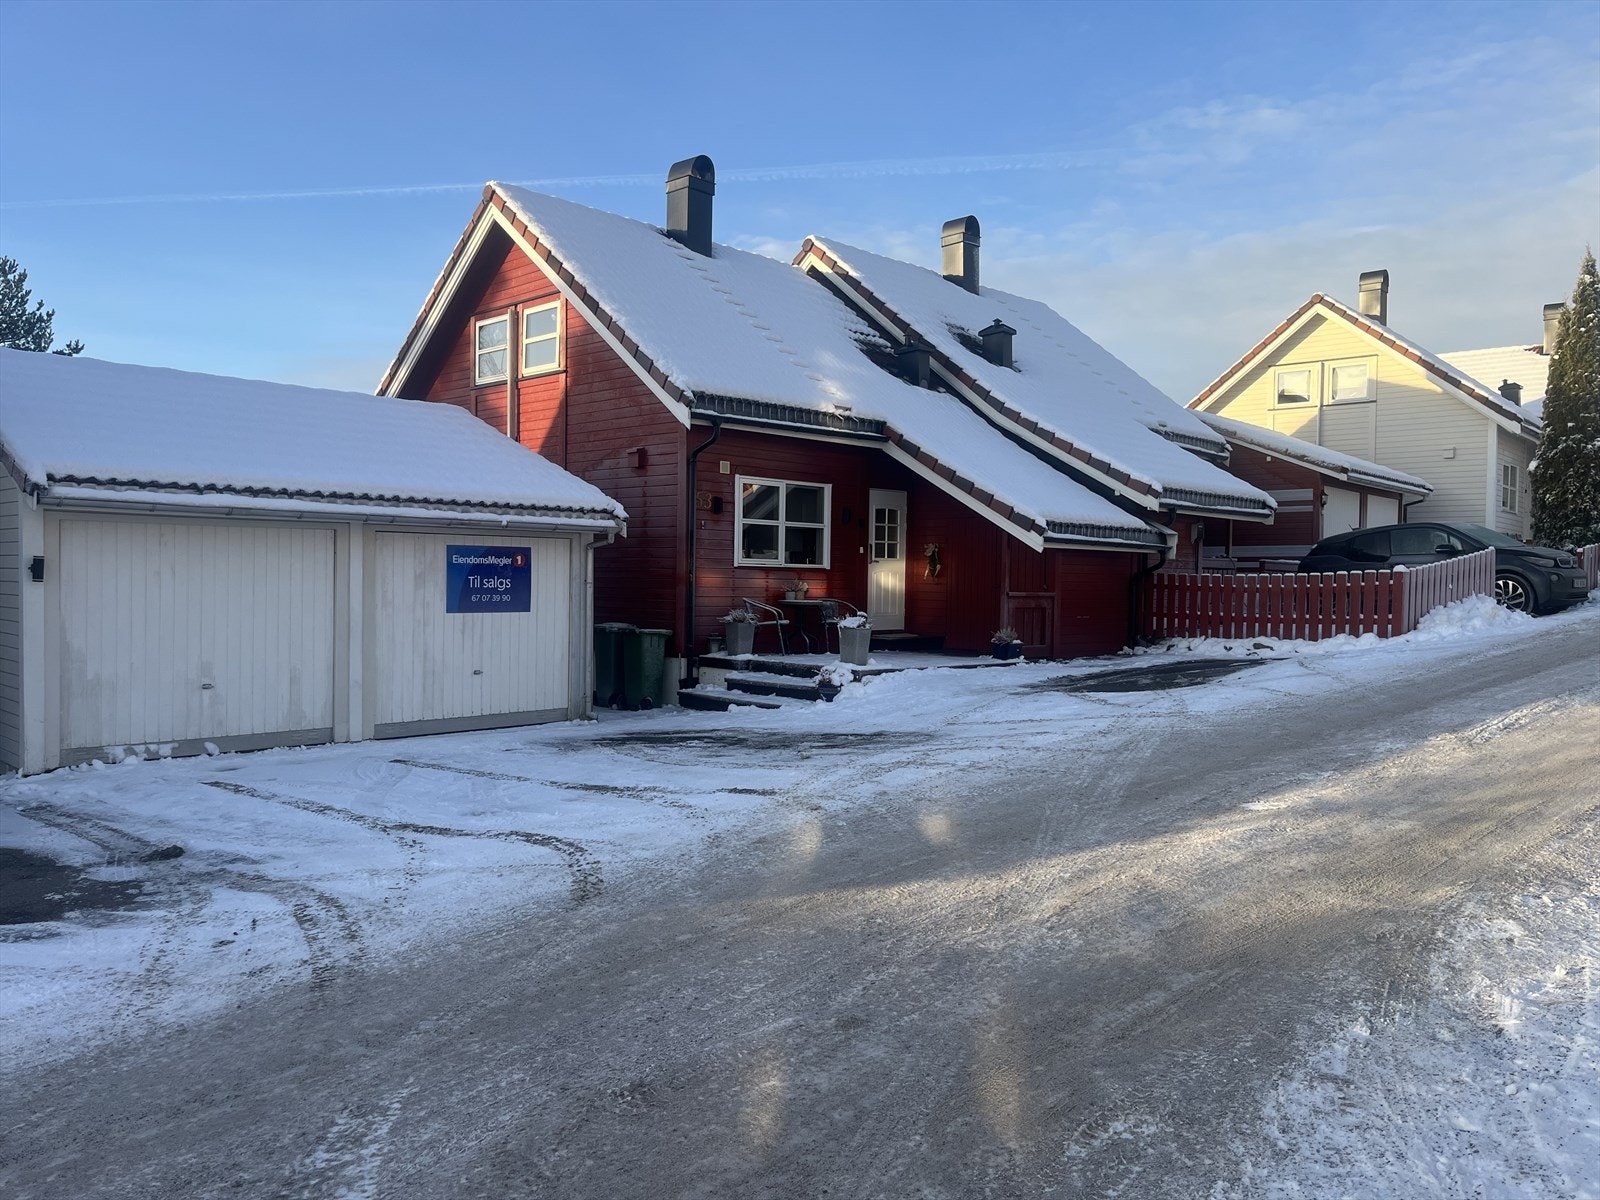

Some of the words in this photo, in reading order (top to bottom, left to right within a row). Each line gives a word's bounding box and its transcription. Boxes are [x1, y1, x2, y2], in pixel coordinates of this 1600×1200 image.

[452, 554, 512, 566] EiendomsMegler
[516, 555, 522, 565] 1
[468, 575, 480, 588] Til
[483, 576, 511, 591] salgs
[471, 594, 480, 602] 67
[481, 594, 490, 602] 07
[491, 594, 500, 602] 39
[501, 594, 511, 602] 90
